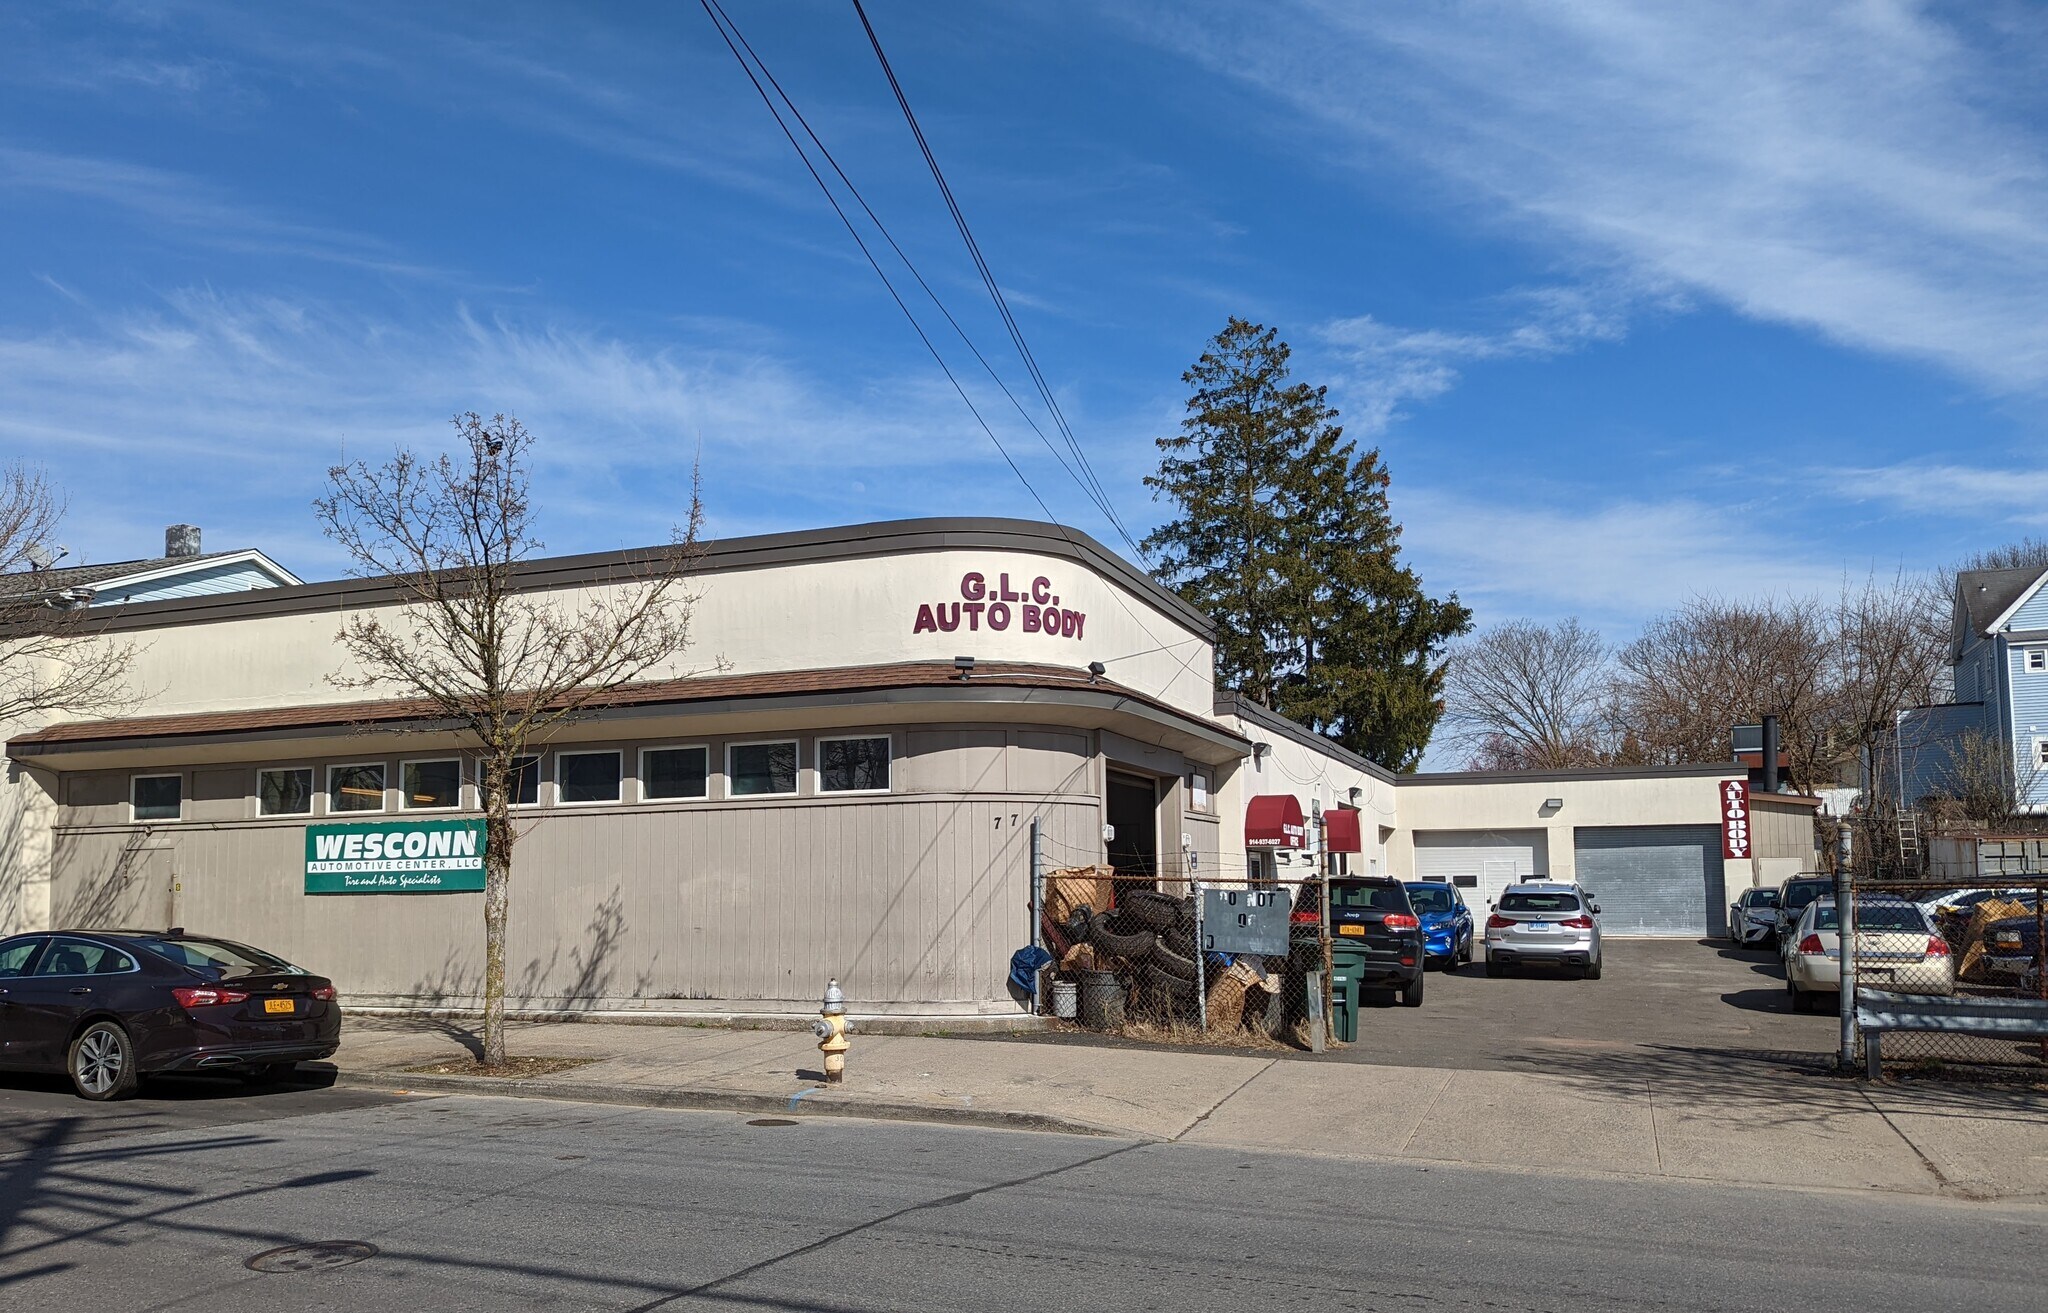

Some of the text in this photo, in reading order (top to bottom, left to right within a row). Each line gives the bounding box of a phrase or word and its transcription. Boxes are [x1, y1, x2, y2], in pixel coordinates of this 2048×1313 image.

[961, 572, 1060, 605] G.L.C.
[913, 602, 1086, 641] AUTO BODY
[1725, 781, 1748, 857] AUTOBODY
[315, 830, 477, 860] WESCONN
[311, 861, 392, 871] AUTOMOTIVE
[456, 858, 479, 868] LLC
[344, 872, 442, 889] Tire and Auto Specialists
